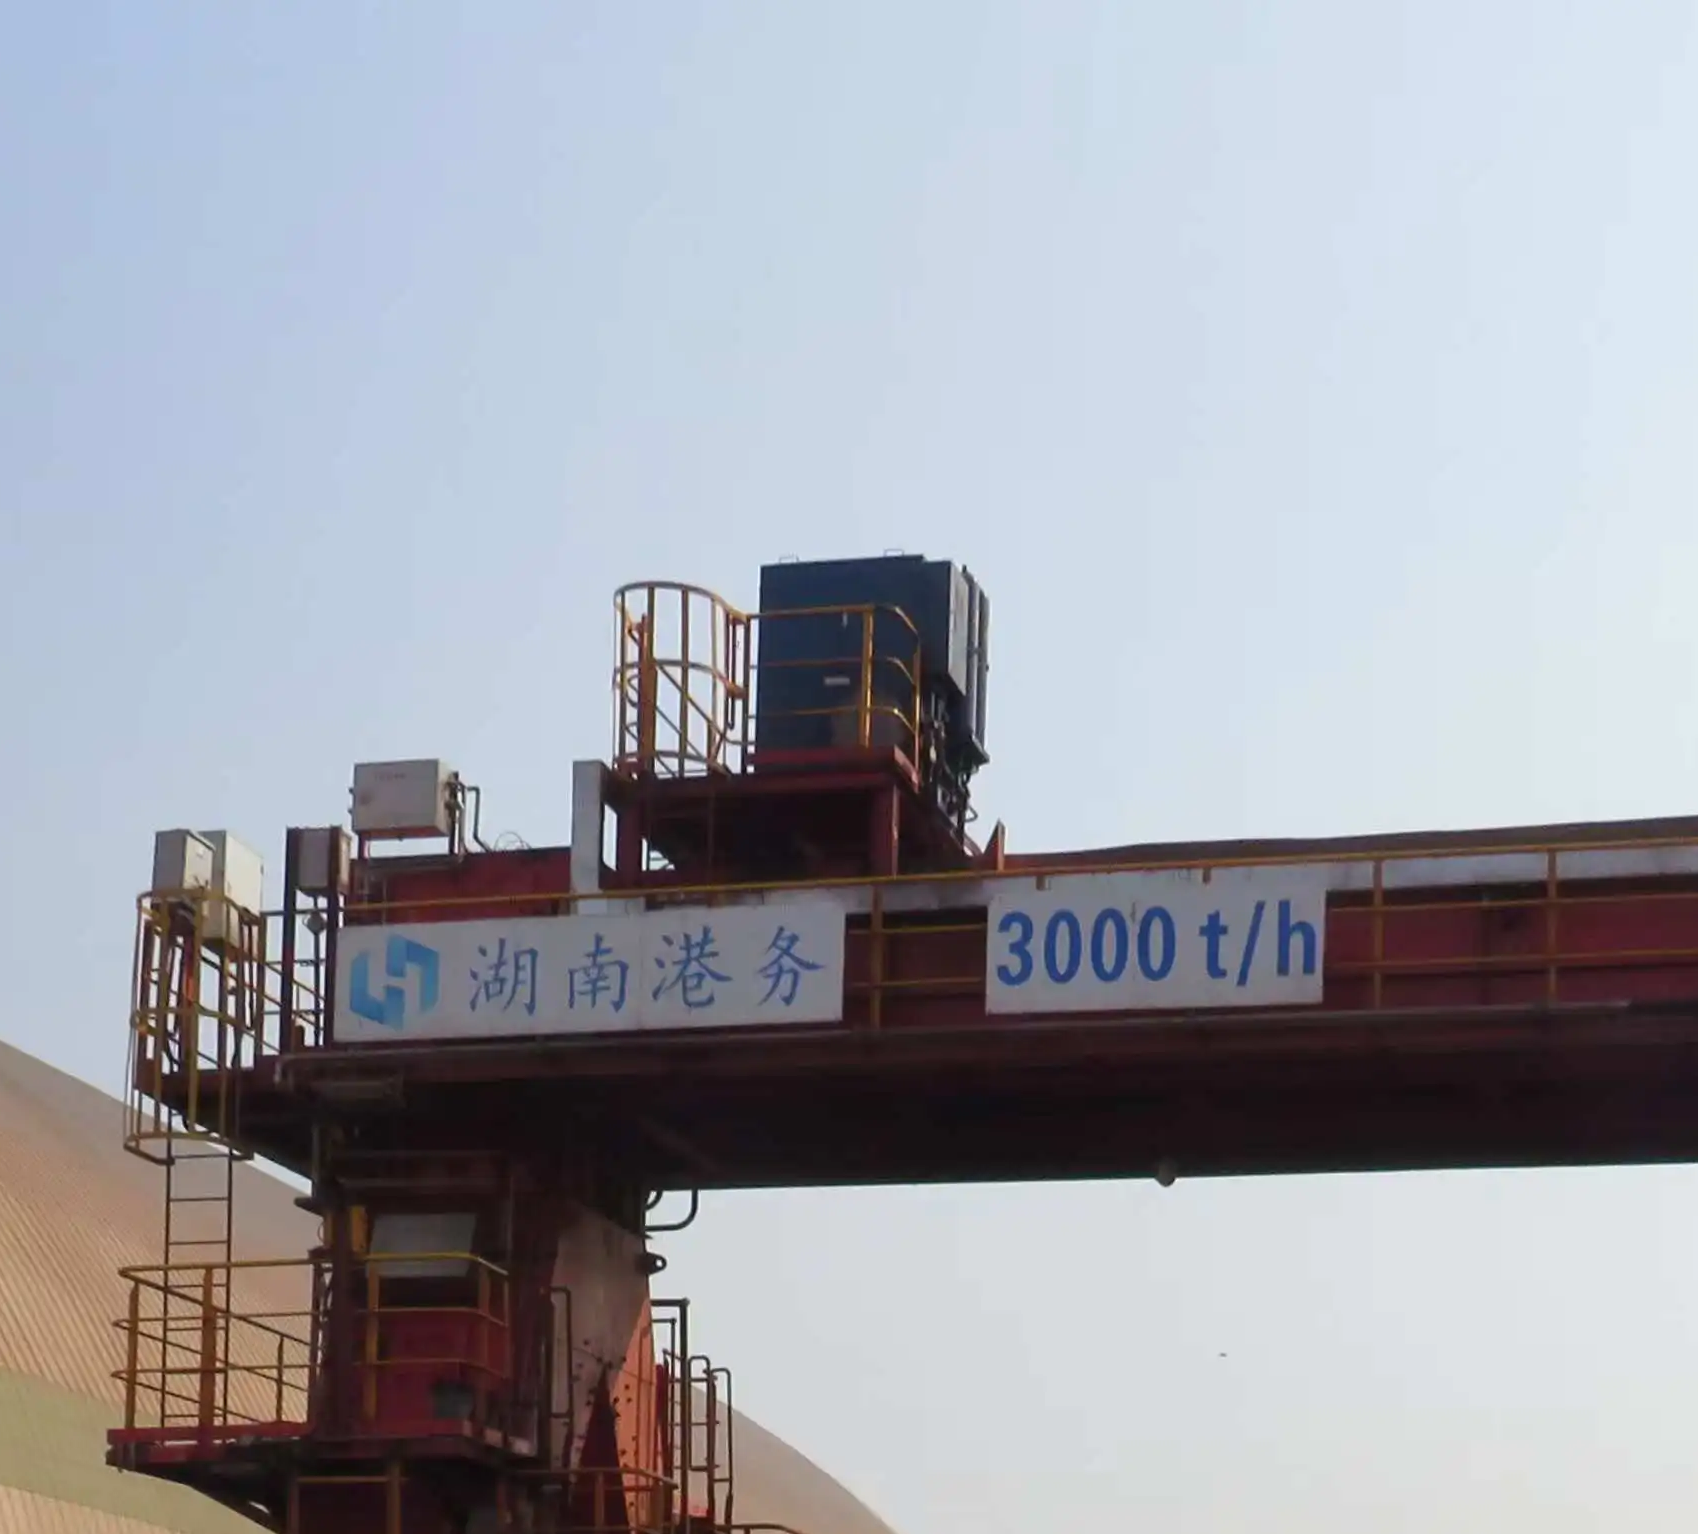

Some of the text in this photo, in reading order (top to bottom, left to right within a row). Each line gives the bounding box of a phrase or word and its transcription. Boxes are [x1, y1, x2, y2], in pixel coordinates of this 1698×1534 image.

[466, 922, 829, 1017] 湖南港务
[996, 900, 1320, 987] 3000 t/h
